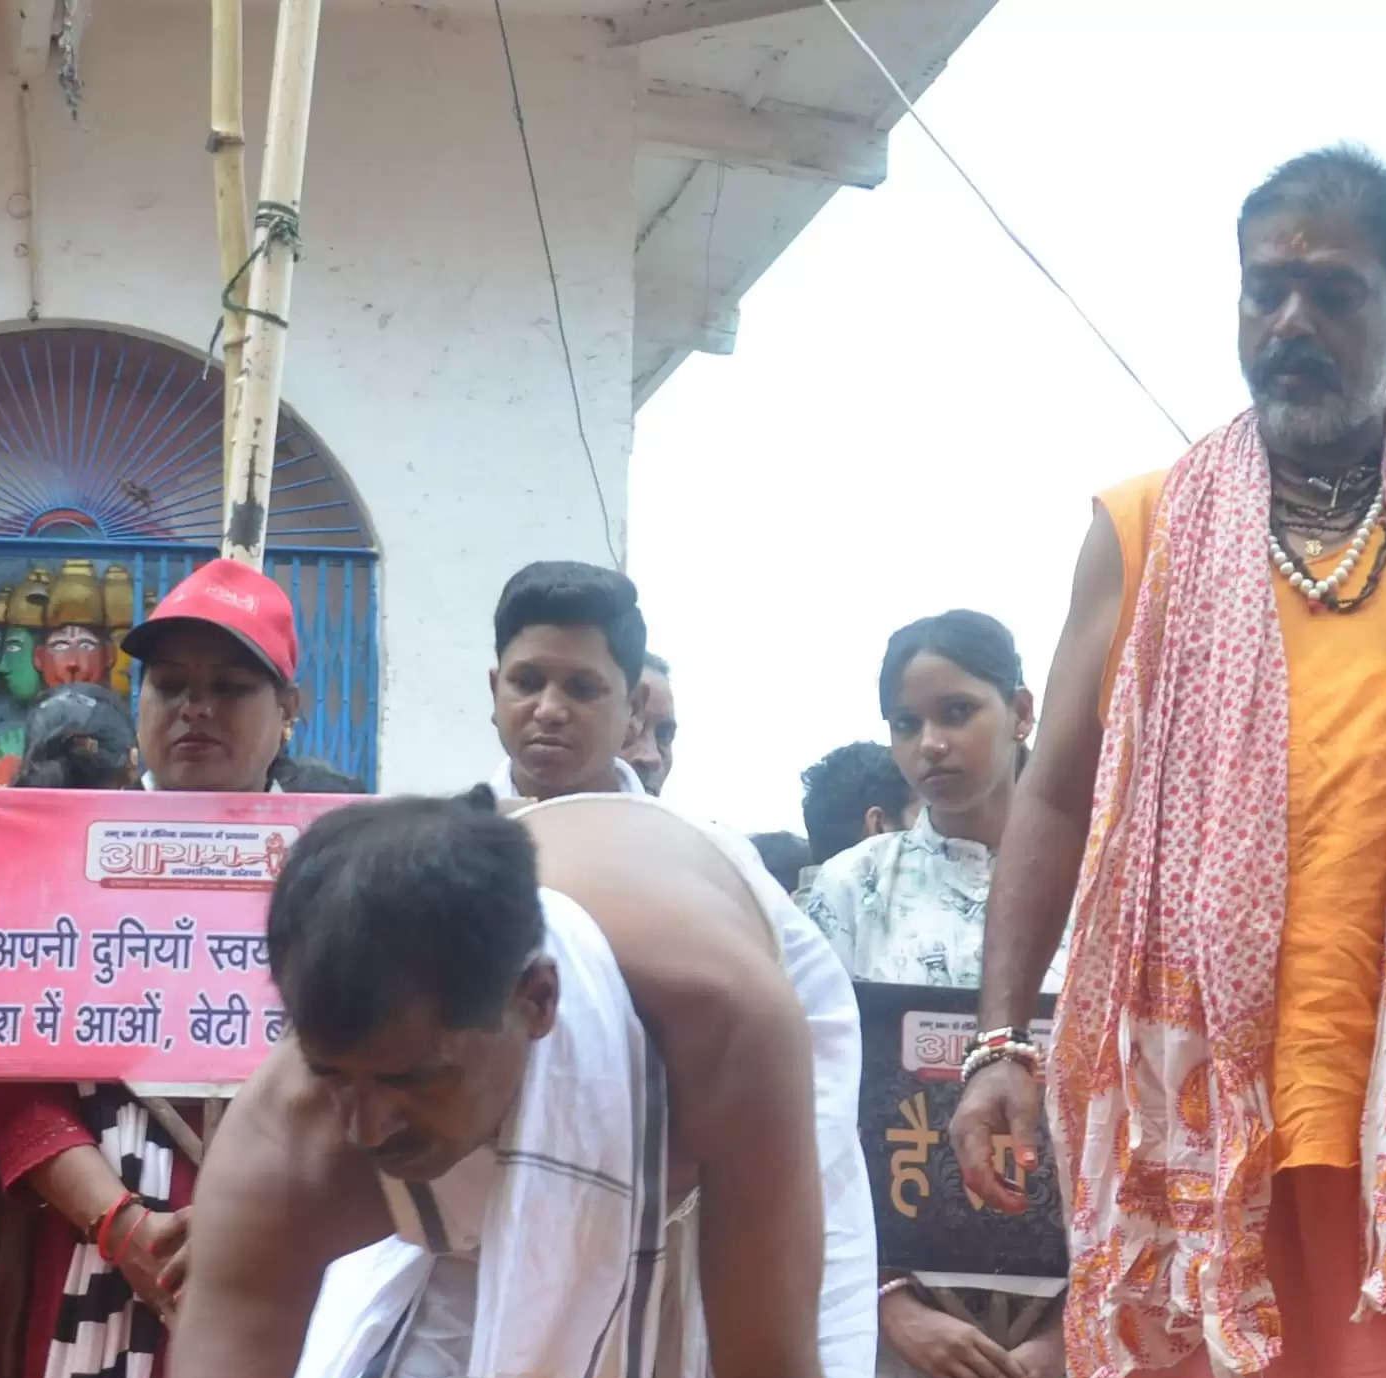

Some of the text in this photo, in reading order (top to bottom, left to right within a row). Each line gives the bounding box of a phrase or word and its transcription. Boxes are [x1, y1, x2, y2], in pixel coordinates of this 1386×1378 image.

[94, 918, 195, 983] दुनियाँ
[34, 992, 62, 1043] में
[190, 992, 251, 1045] बेटी
